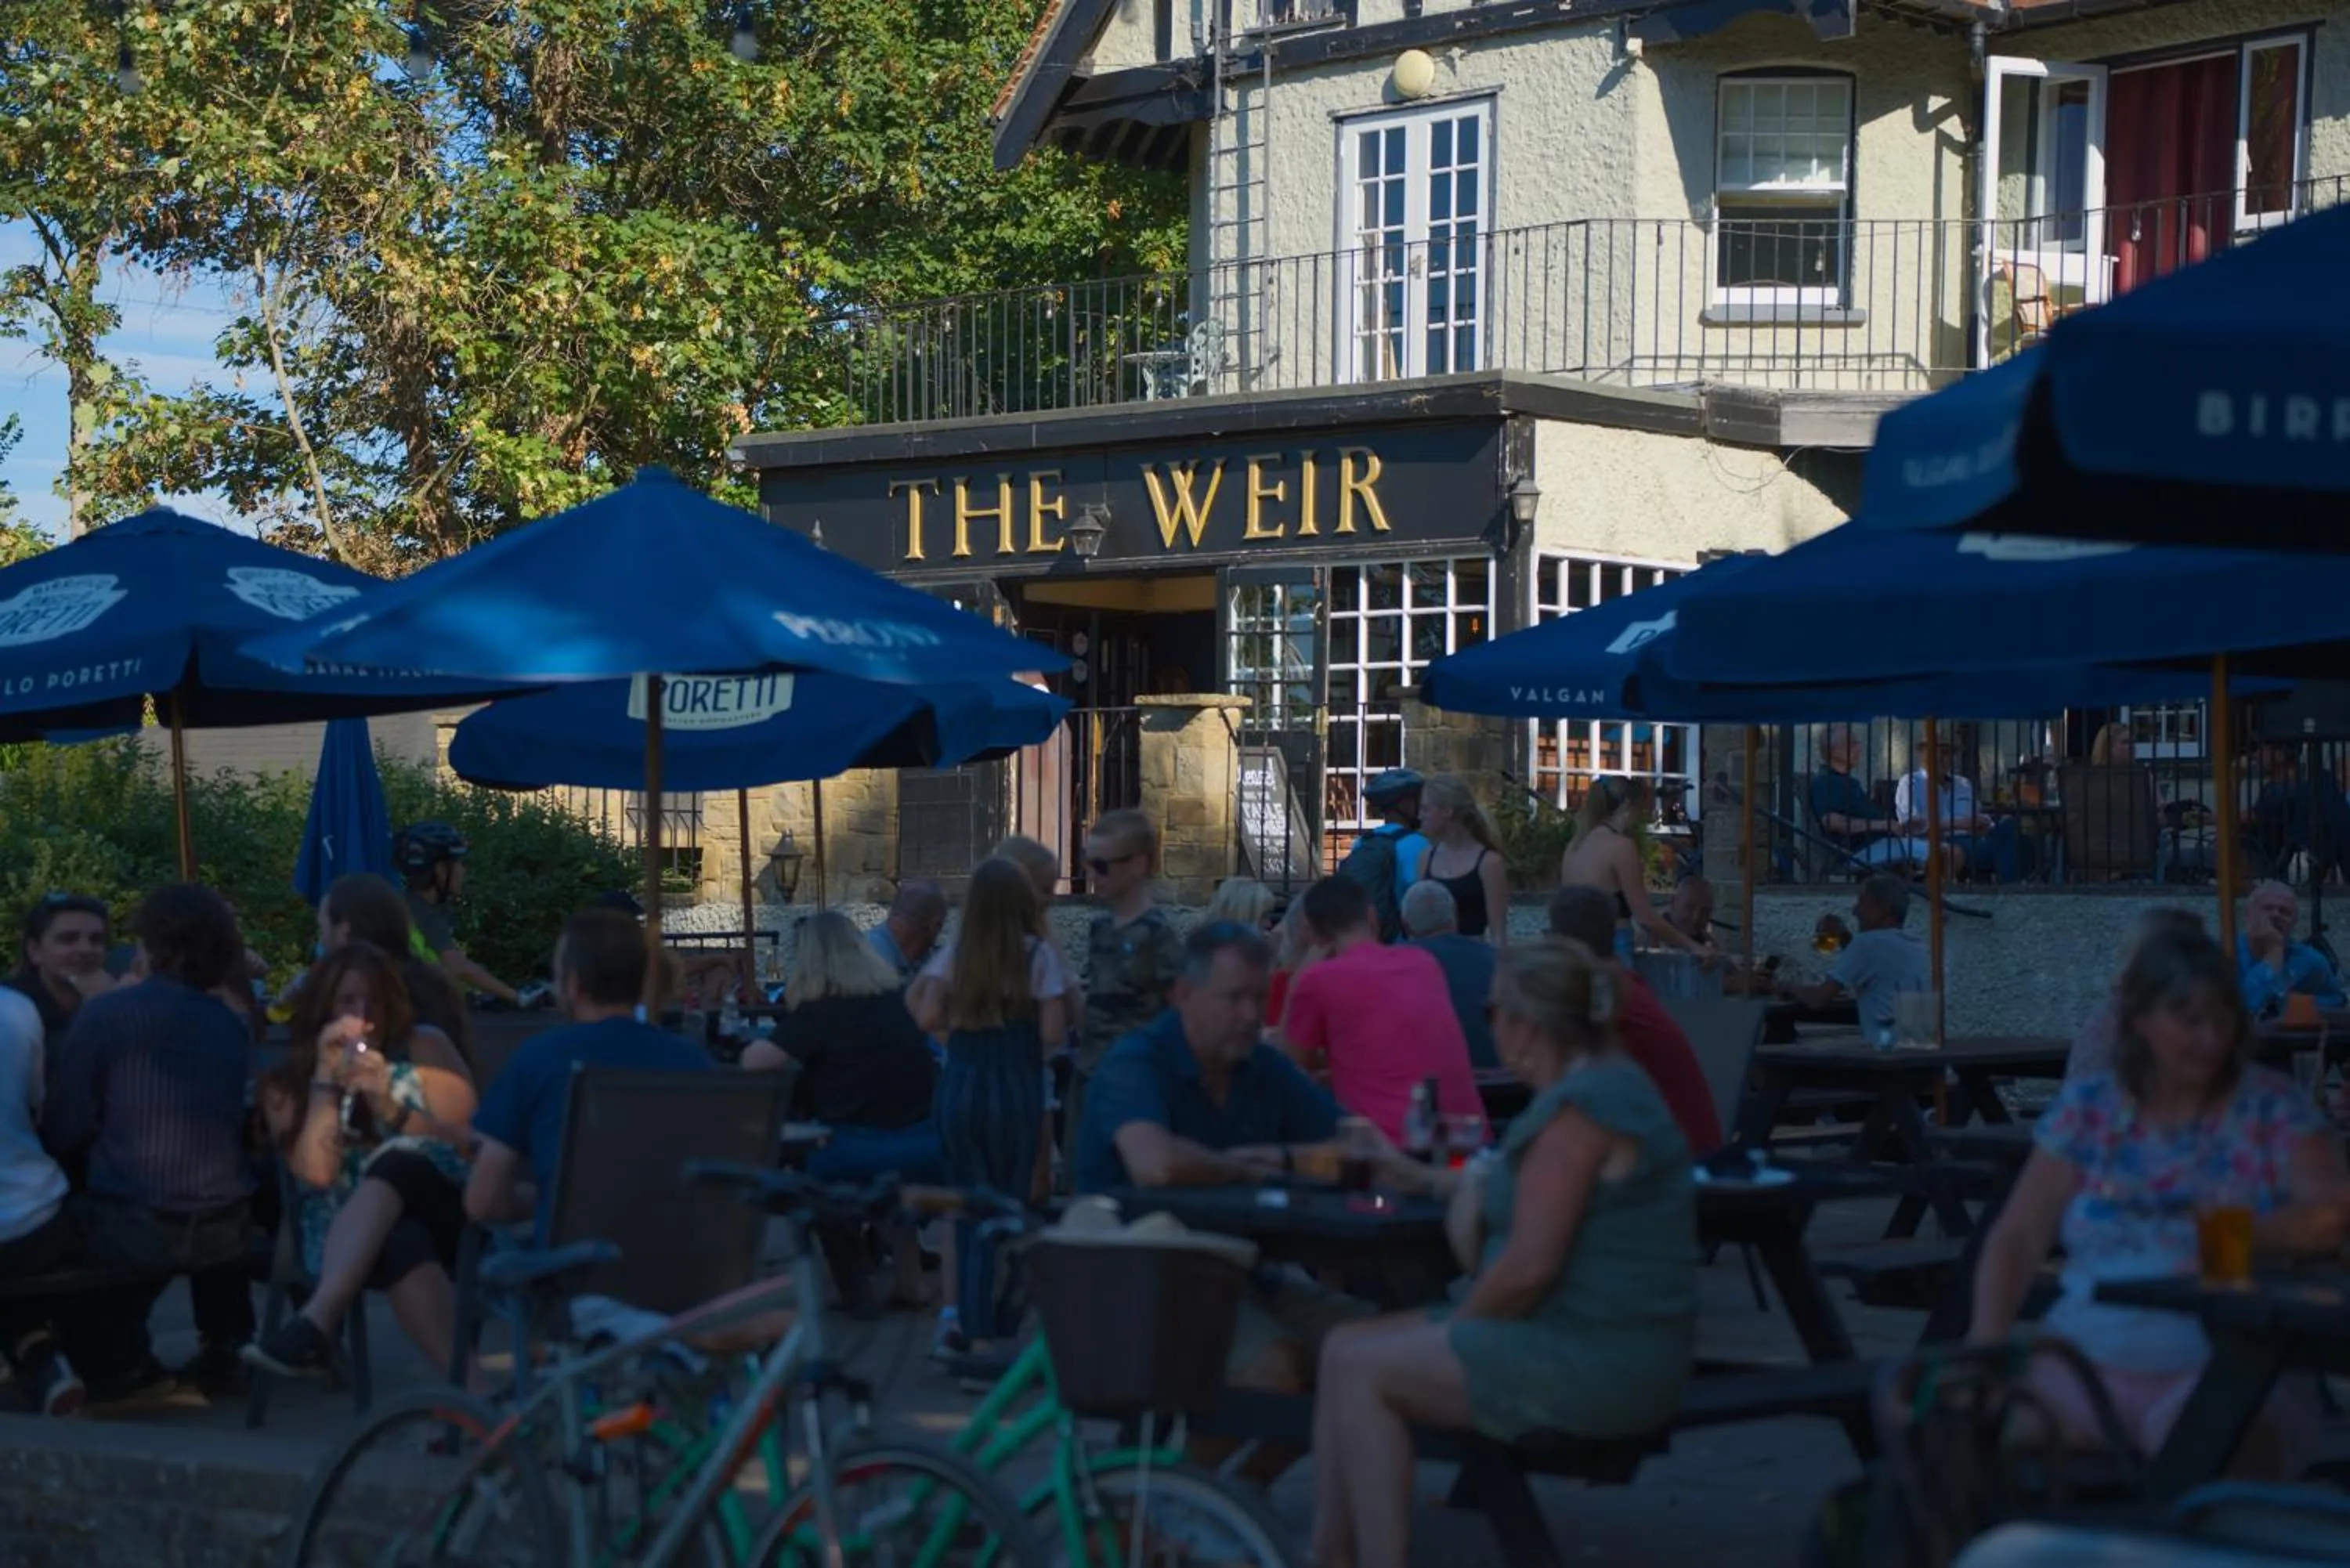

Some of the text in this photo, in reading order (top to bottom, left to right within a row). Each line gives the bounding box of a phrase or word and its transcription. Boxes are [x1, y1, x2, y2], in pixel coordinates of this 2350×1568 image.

[888, 446, 1392, 561] THE WEIR
[46, 656, 143, 690] PORETTI
[1509, 686, 1606, 703] VALGAN
